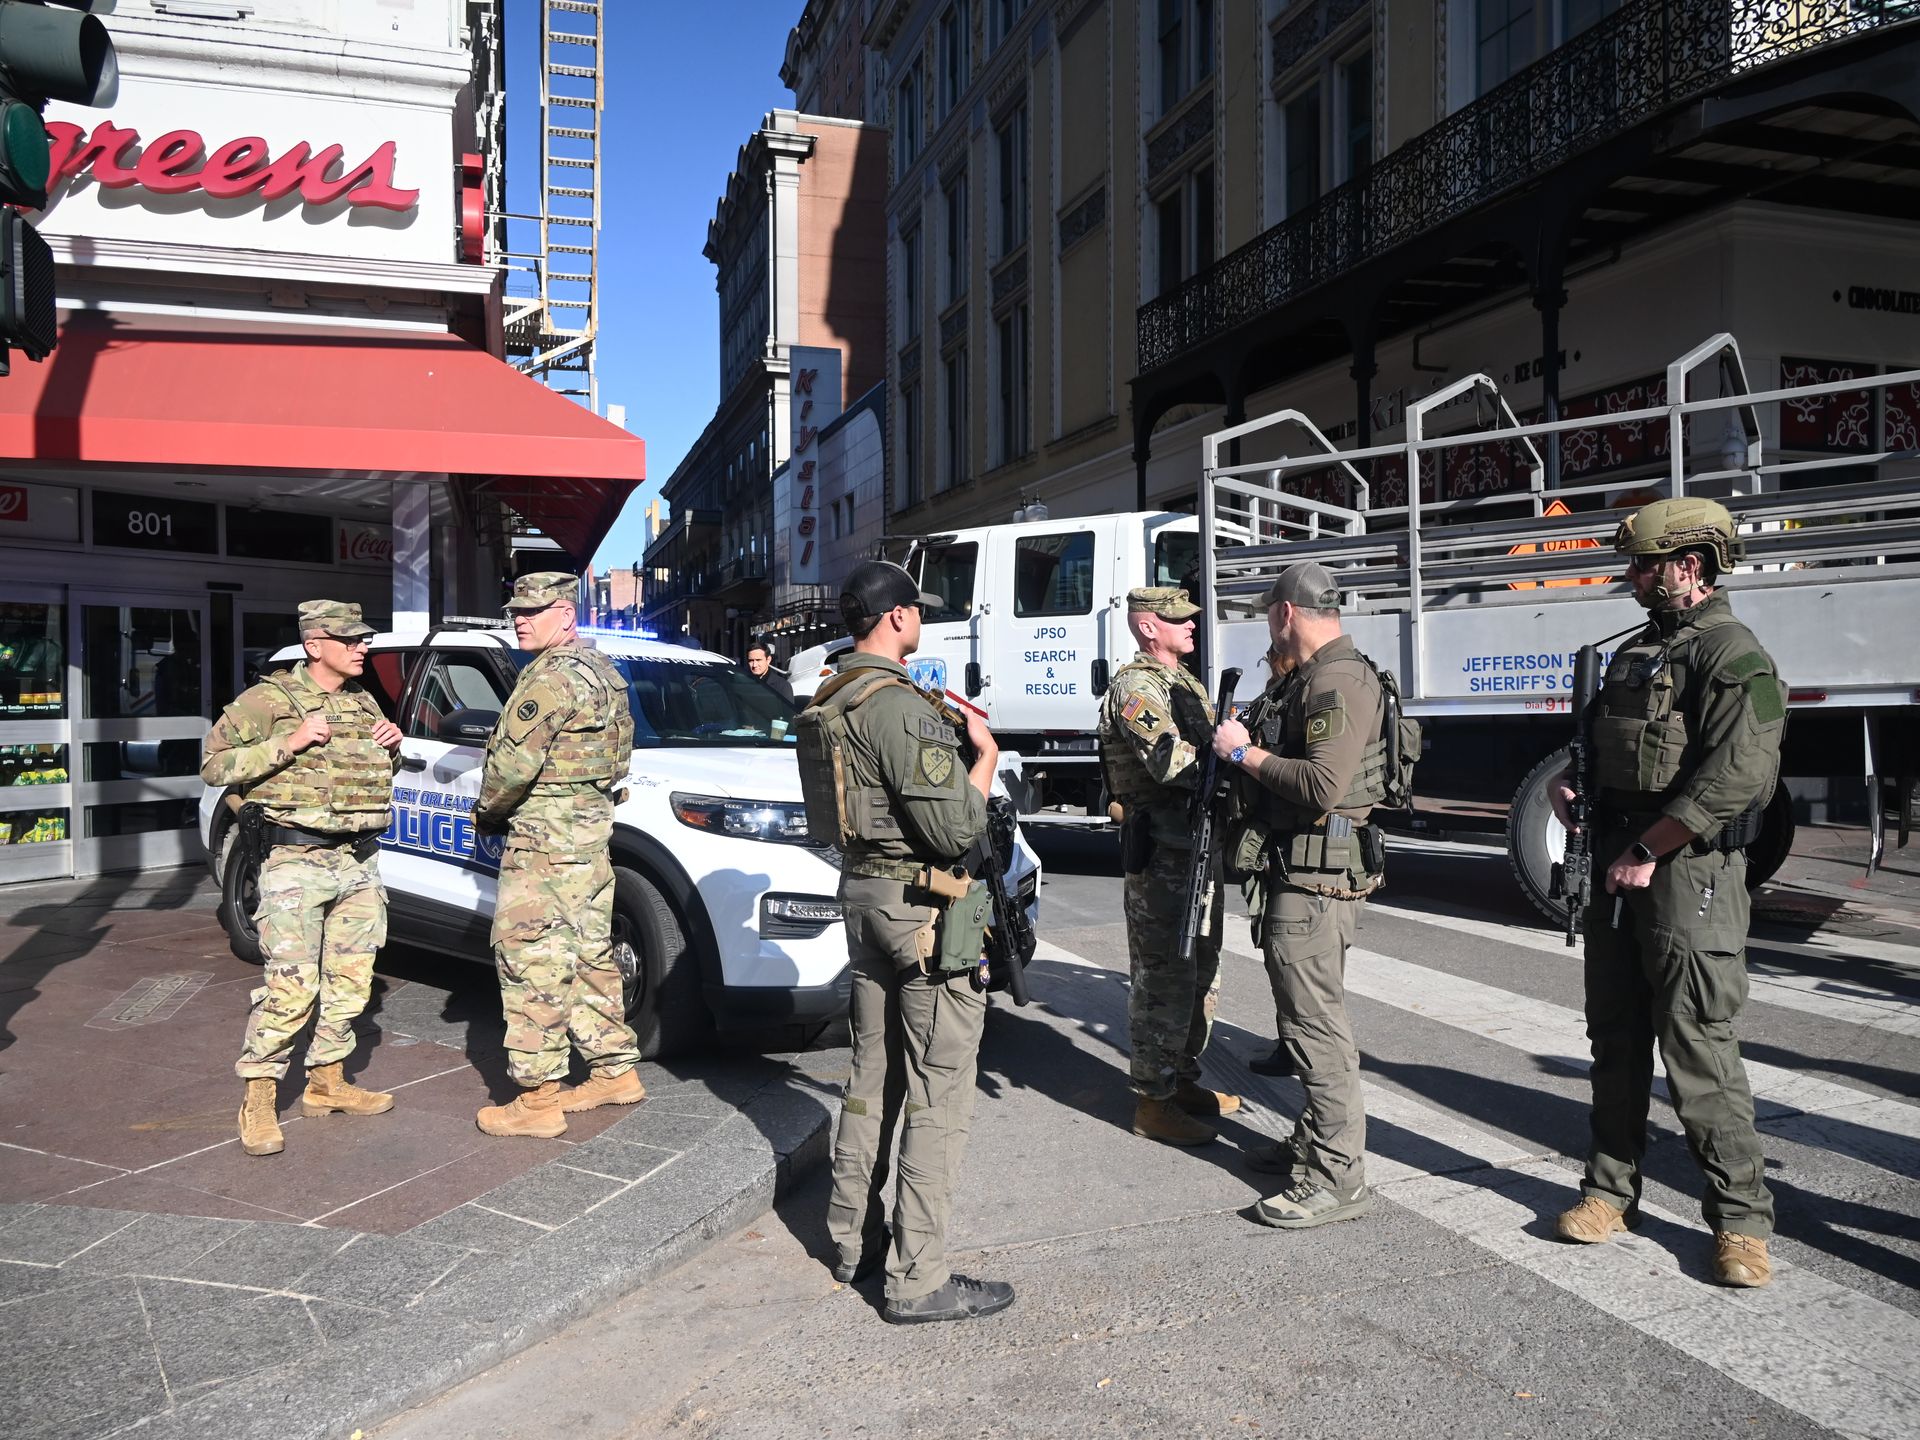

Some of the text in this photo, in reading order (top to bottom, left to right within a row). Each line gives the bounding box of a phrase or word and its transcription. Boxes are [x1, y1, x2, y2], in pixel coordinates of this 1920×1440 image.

[794, 367, 819, 566] Krystal
[127, 510, 172, 537] 801
[1033, 626, 1067, 640] JPSO
[1024, 649, 1076, 663] SEARCH
[1462, 653, 1562, 673] JEFFERSON
[1046, 666, 1055, 679] &
[1025, 683, 1077, 695] RESCUE
[1470, 674, 1556, 692] SHERIFF'S
[1524, 697, 1573, 712] Dial 91
[393, 786, 477, 813] NEW ORLEANS
[375, 804, 477, 860] OLICE
